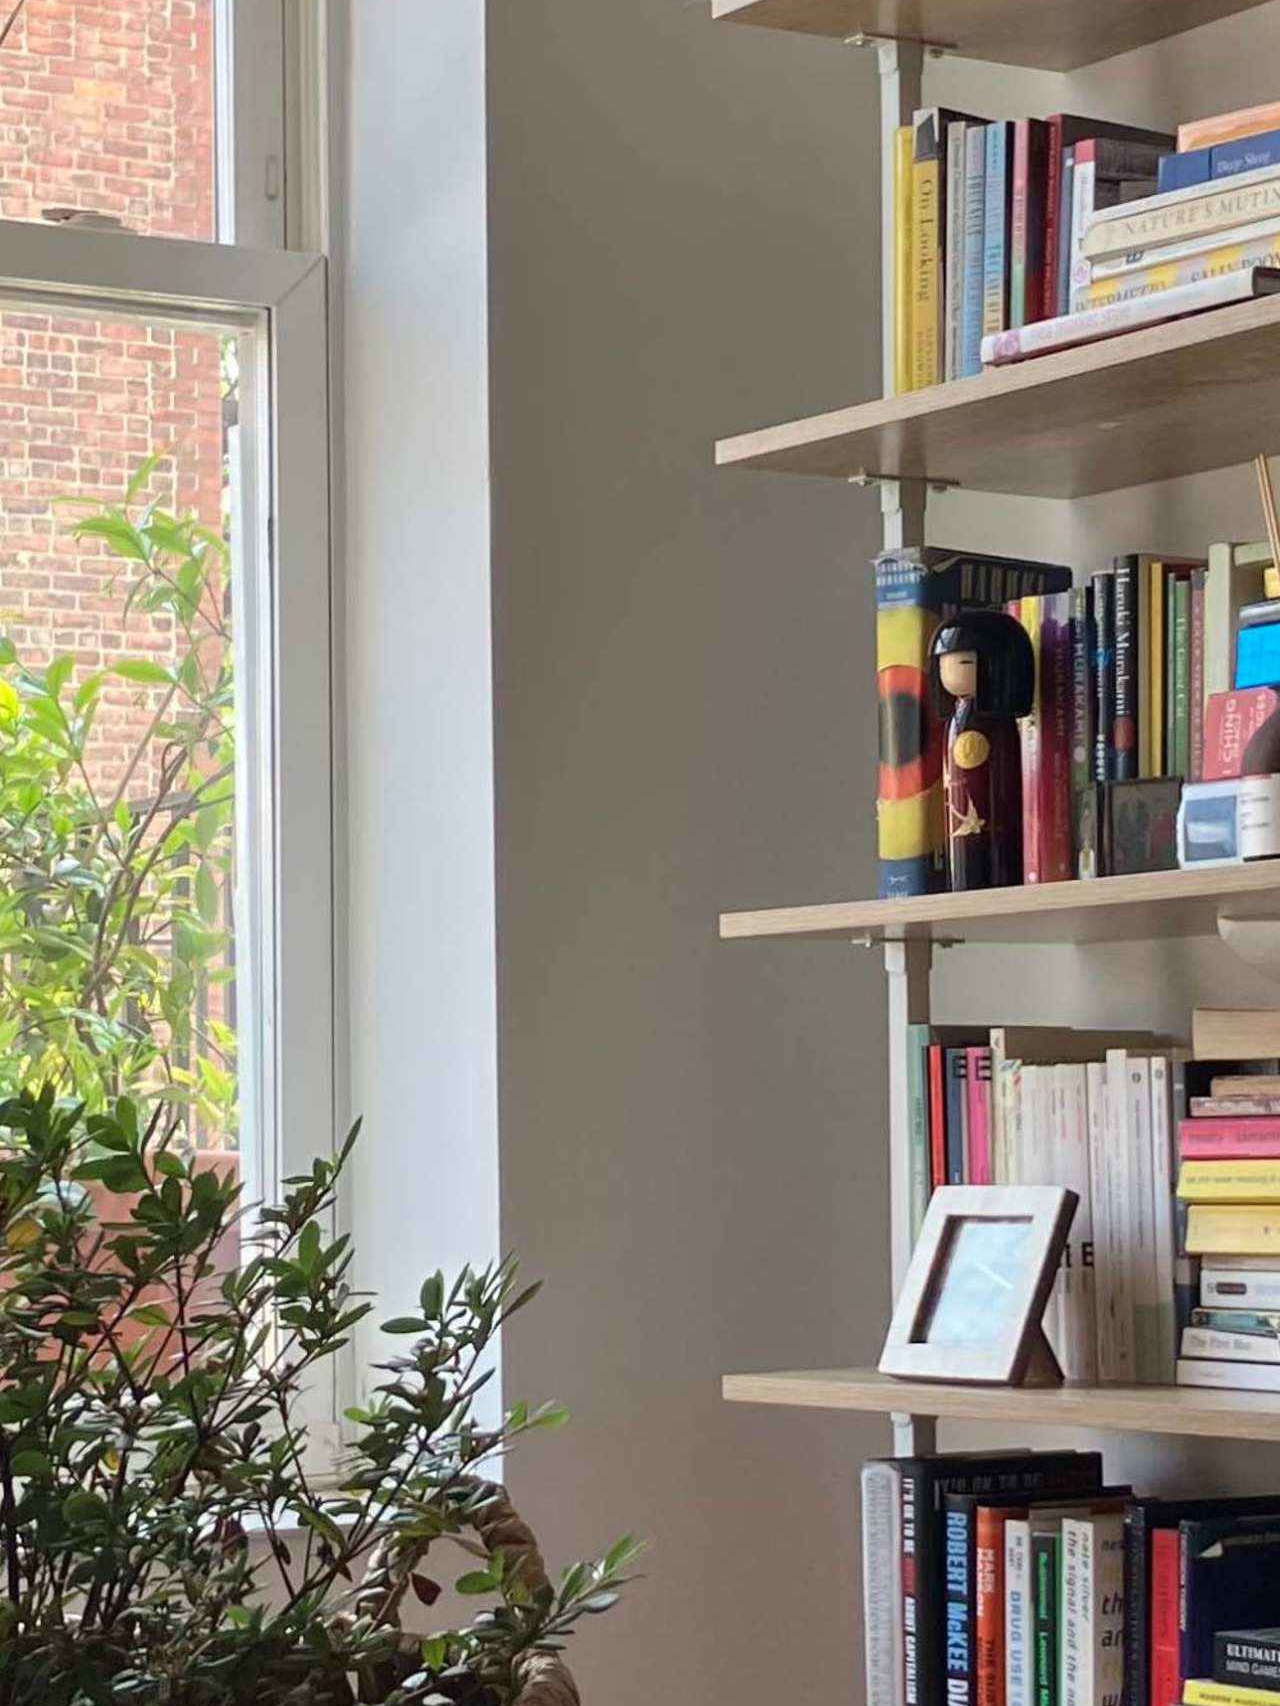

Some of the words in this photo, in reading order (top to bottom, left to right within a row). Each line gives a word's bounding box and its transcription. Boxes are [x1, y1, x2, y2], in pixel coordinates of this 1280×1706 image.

[921, 179, 935, 210] On
[1123, 204, 1211, 236] NATURE'S
[919, 216, 935, 302] Looking
[1117, 567, 1130, 627] Haruki
[1074, 642, 1087, 740] MURAKAMI
[1116, 630, 1130, 716] Murakami
[946, 1511, 968, 1595] ROBERT
[1067, 1529, 1077, 1556] the
[1082, 1531, 1092, 1570] nate
[983, 1547, 995, 1593] MARK
[1065, 1563, 1077, 1613] signal
[1009, 1590, 1022, 1642] DRUG
[1080, 1575, 1092, 1622] silver
[946, 1602, 968, 1671] McKEE
[1065, 1617, 1076, 1648] and
[905, 1634, 917, 1705] CAPITALISM
[1010, 1649, 1022, 1686] USE
[1065, 1654, 1076, 1681] the
[1225, 1659, 1249, 1675] MIND
